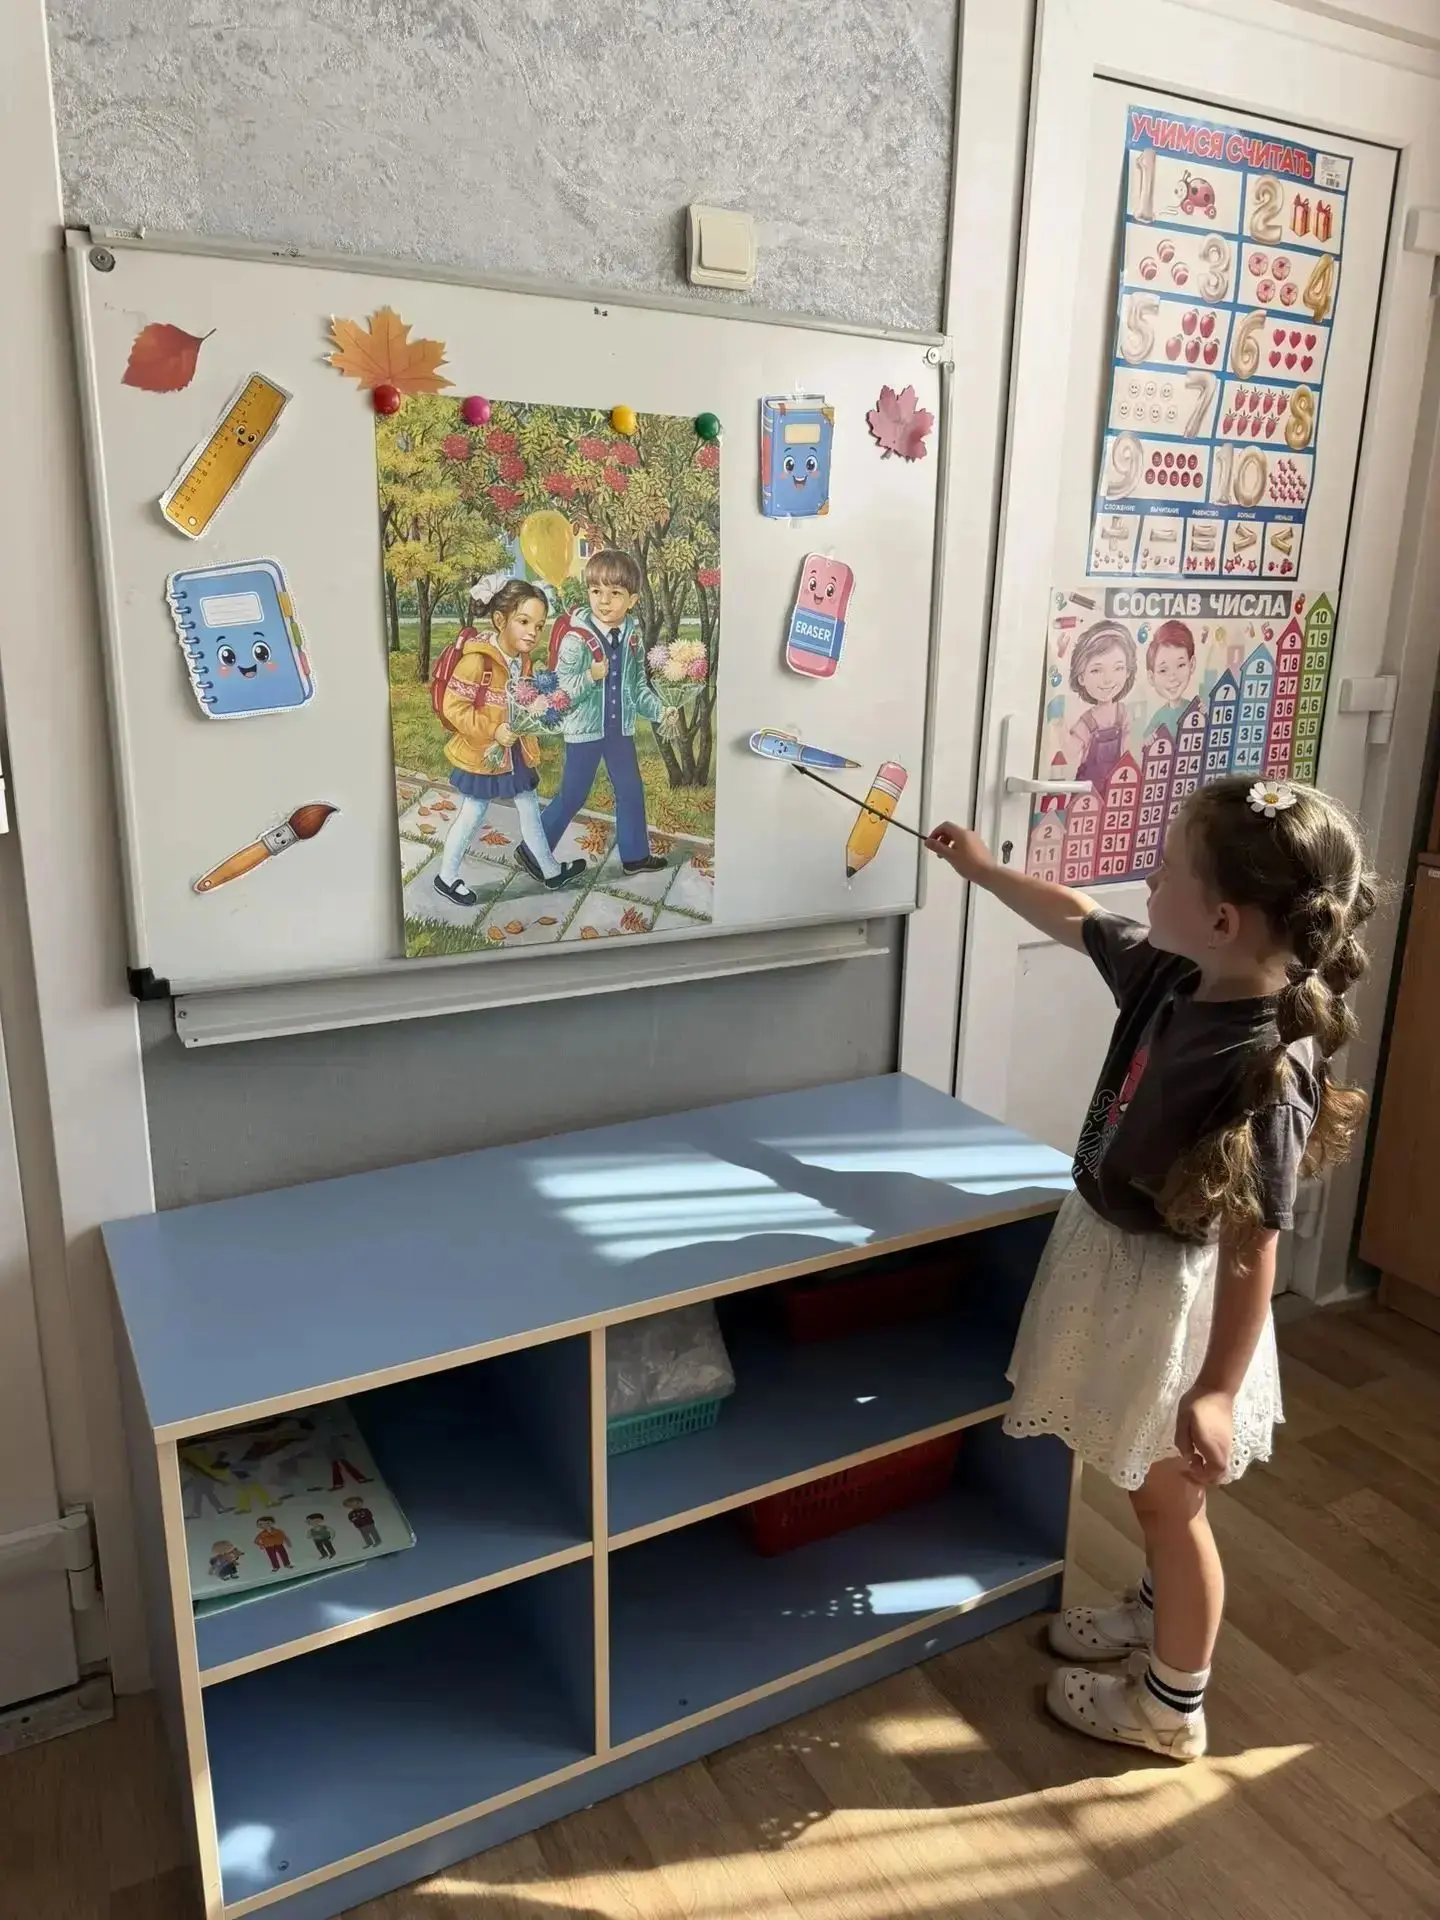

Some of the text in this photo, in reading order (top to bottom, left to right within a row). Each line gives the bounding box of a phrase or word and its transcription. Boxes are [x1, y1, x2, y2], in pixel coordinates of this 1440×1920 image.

[1131, 112, 1314, 180] УЧИМСЯ СЧИТАТЬ
[1134, 149, 1157, 223] 1
[1249, 174, 1284, 245] 2
[1200, 233, 1231, 304] 3
[1303, 254, 1334, 323] 4
[1120, 291, 1160, 364] 5
[1230, 309, 1267, 380] 6
[1184, 370, 1217, 439] 7
[1284, 384, 1315, 450] 8
[1105, 430, 1144, 501] 9
[1214, 442, 1268, 508] 10
[1112, 592, 1287, 617] СОСТАВ ЧИСЛА
[1315, 610, 1328, 623] 10
[795, 620, 831, 642] ERASER
[1289, 635, 1296, 648] 9
[1256, 661, 1264, 673] 8
[1224, 687, 1230, 699] 7
[1191, 714, 1199, 727] 6
[1158, 742, 1165, 754] 5
[1119, 769, 1128, 781] 4
[1082, 798, 1090, 810] 3
[1044, 826, 1053, 839] 2
